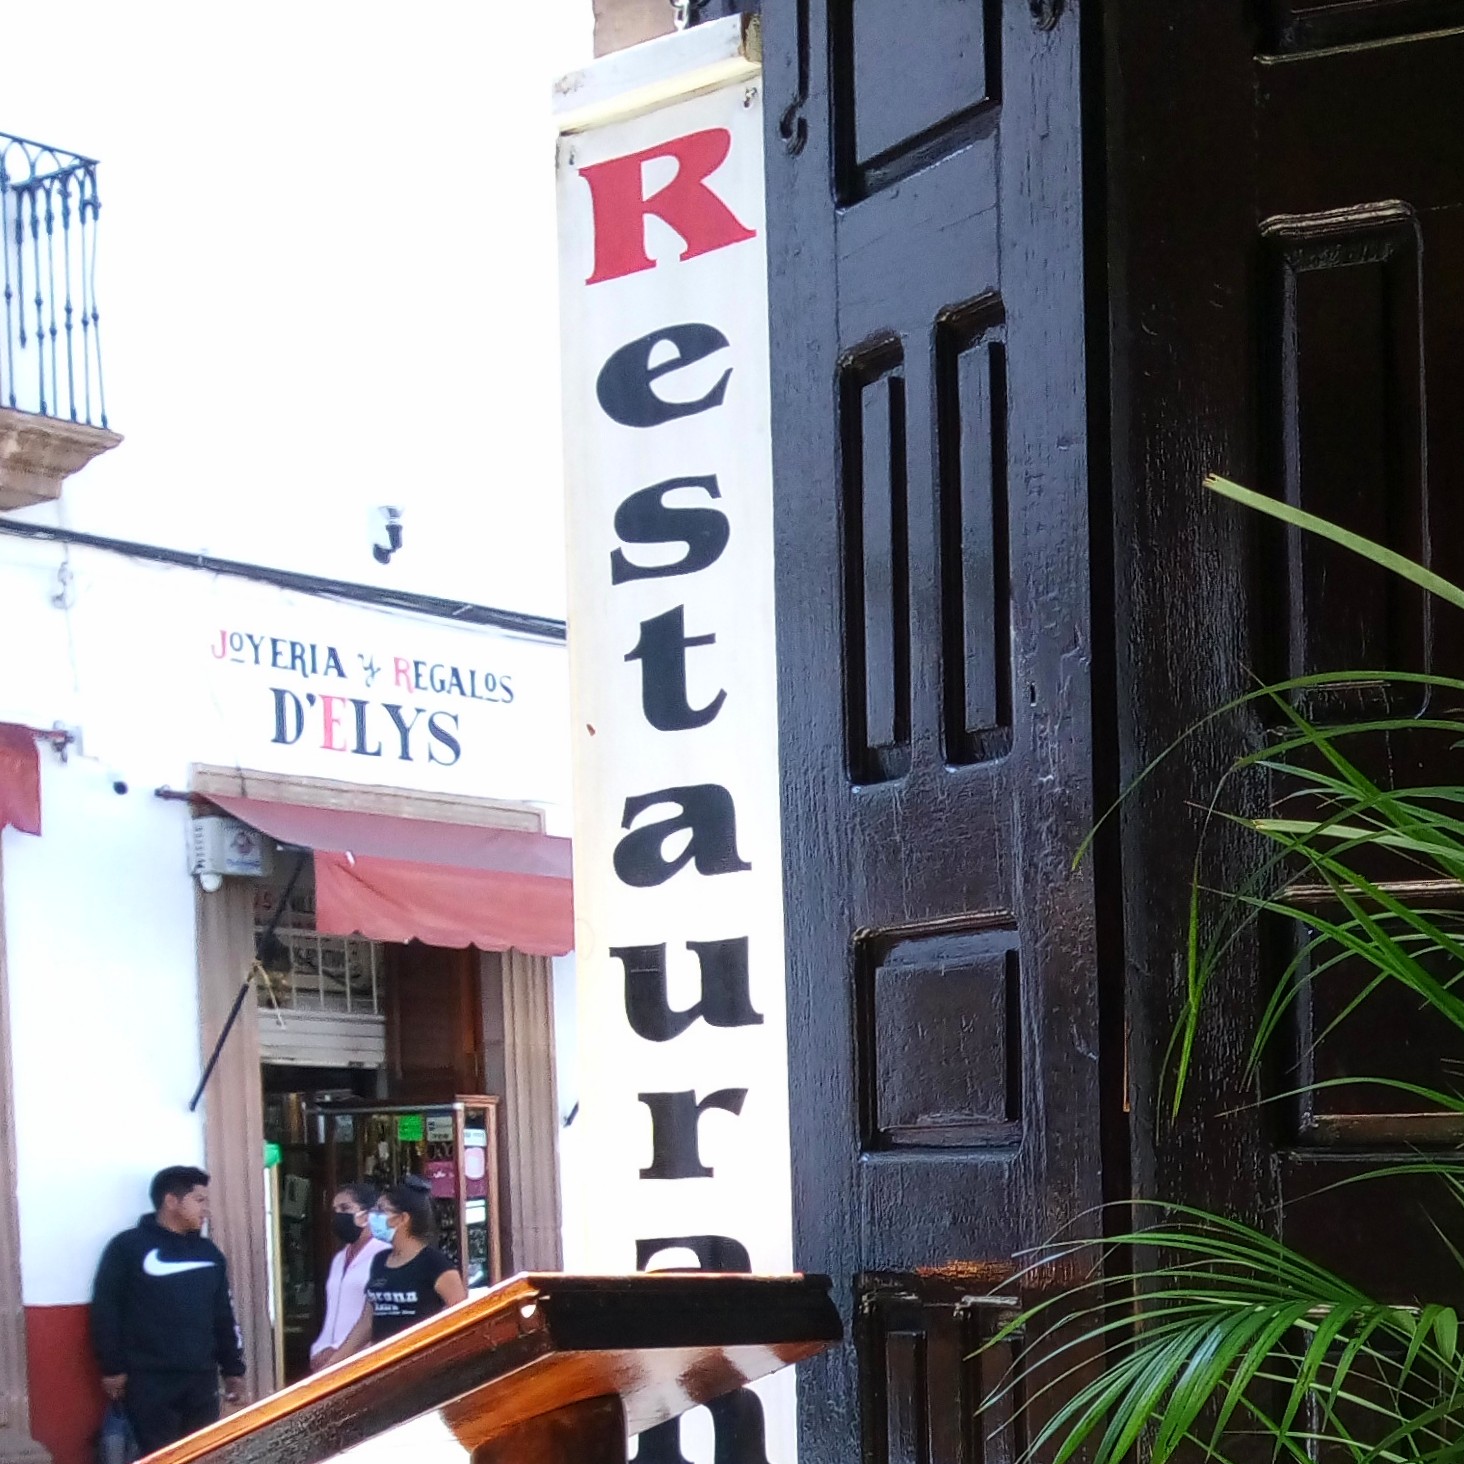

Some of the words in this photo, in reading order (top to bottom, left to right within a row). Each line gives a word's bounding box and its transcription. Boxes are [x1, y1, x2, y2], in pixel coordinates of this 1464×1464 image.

[211, 630, 348, 679] JOYERIA
[393, 656, 514, 704] REGALOS
[268, 687, 462, 767] D'ELYS
